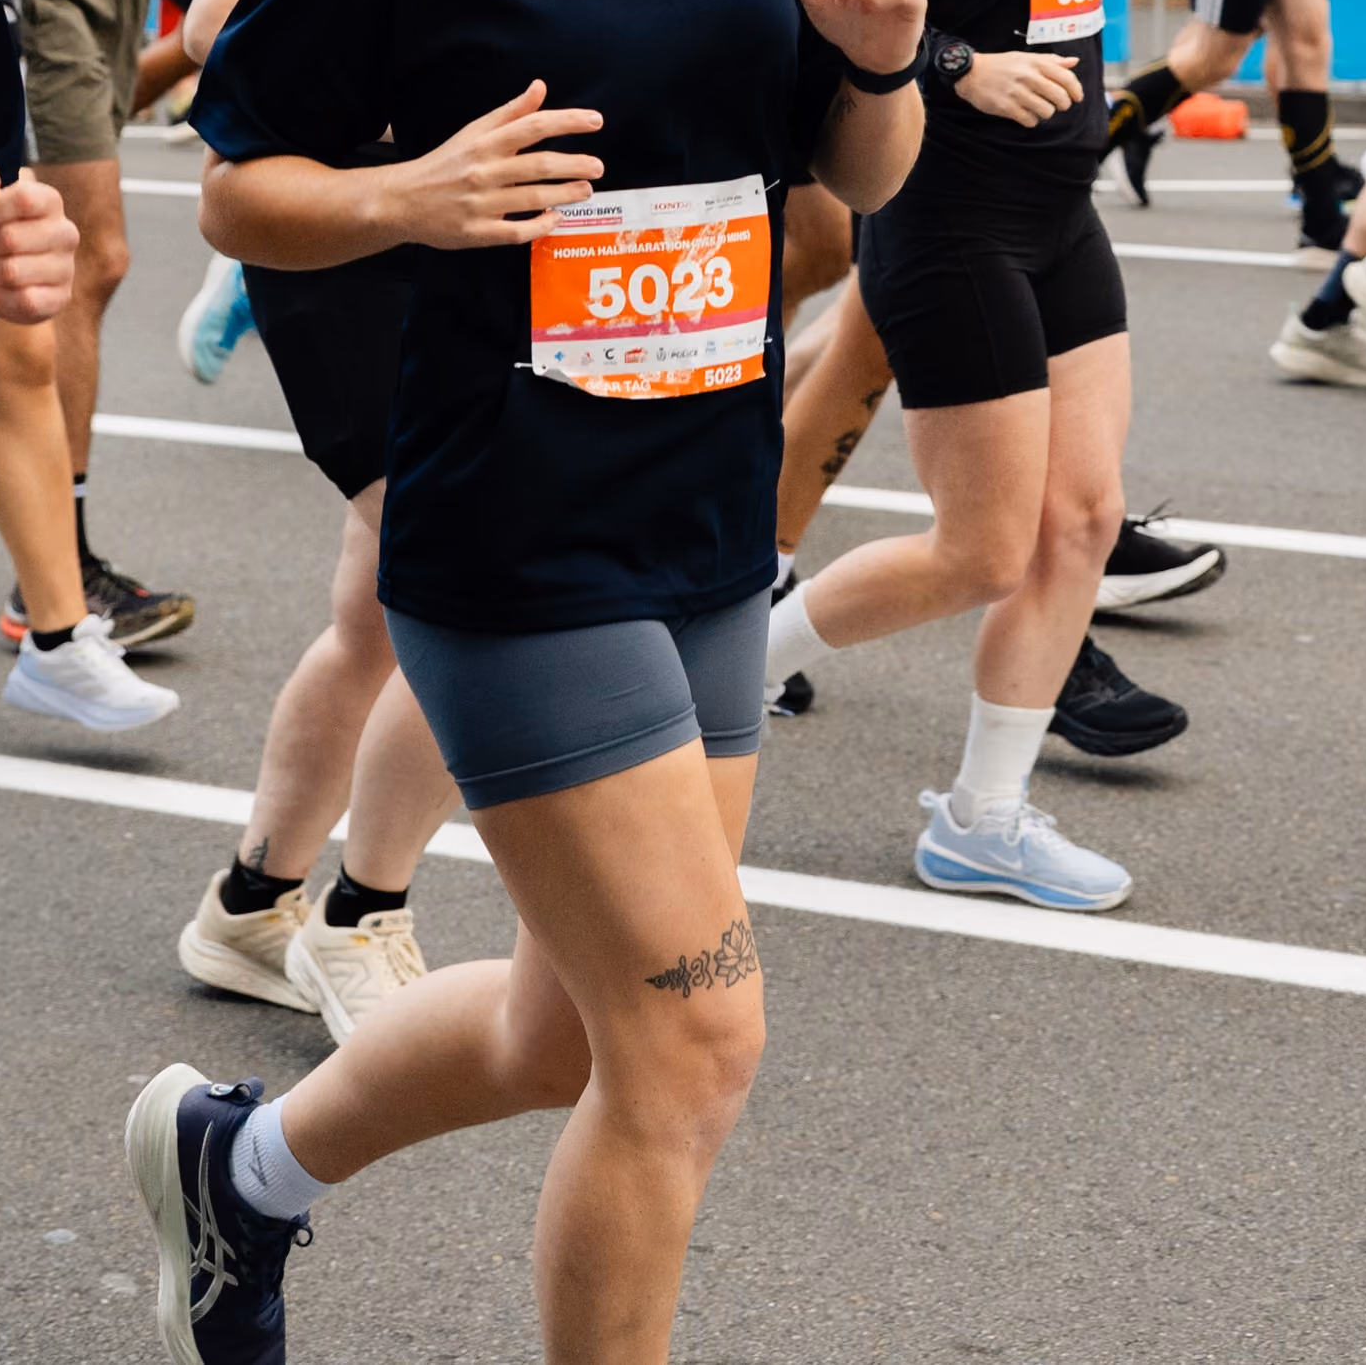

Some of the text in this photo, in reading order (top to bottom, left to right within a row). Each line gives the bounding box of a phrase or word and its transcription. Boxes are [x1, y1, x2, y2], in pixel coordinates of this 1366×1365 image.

[553, 246, 596, 259] HONDA
[627, 239, 691, 254] MARATHON
[587, 256, 735, 319] 5023
[622, 379, 651, 393] TAG
[704, 363, 742, 387] 5023
